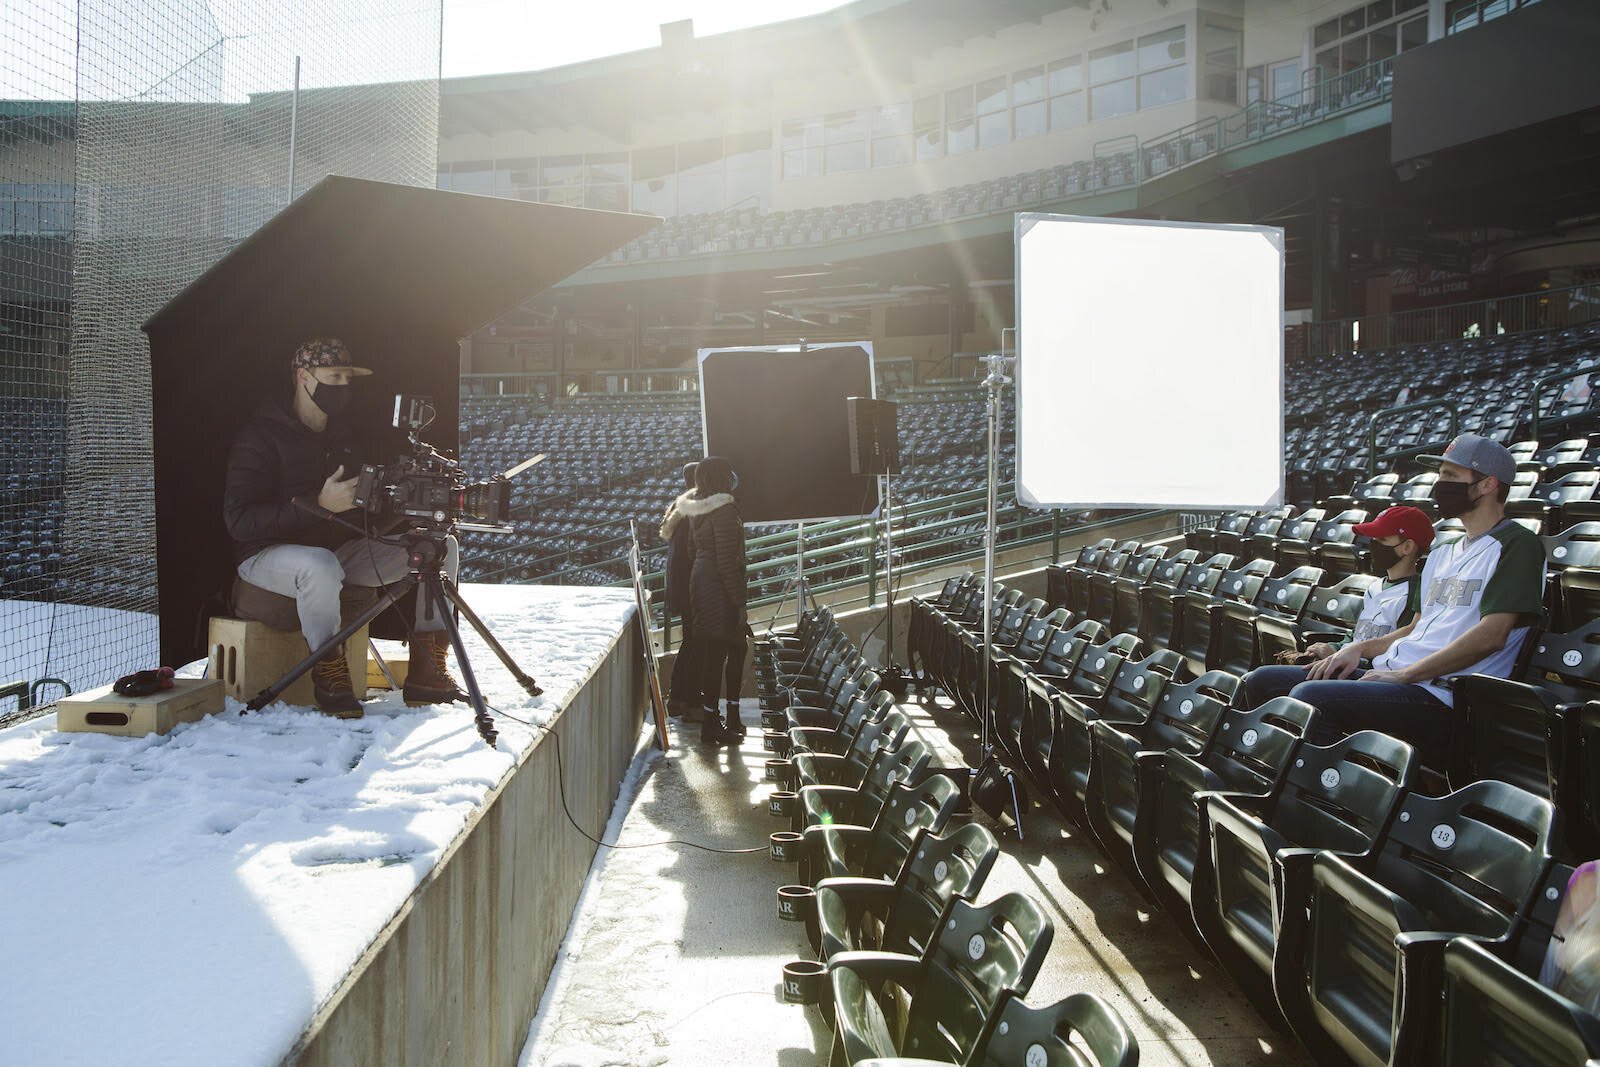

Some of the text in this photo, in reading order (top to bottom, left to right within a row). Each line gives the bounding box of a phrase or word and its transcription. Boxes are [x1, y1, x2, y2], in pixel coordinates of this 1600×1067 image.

[1418, 280, 1469, 296] TEAM STORE
[1437, 830, 1450, 842] 13
